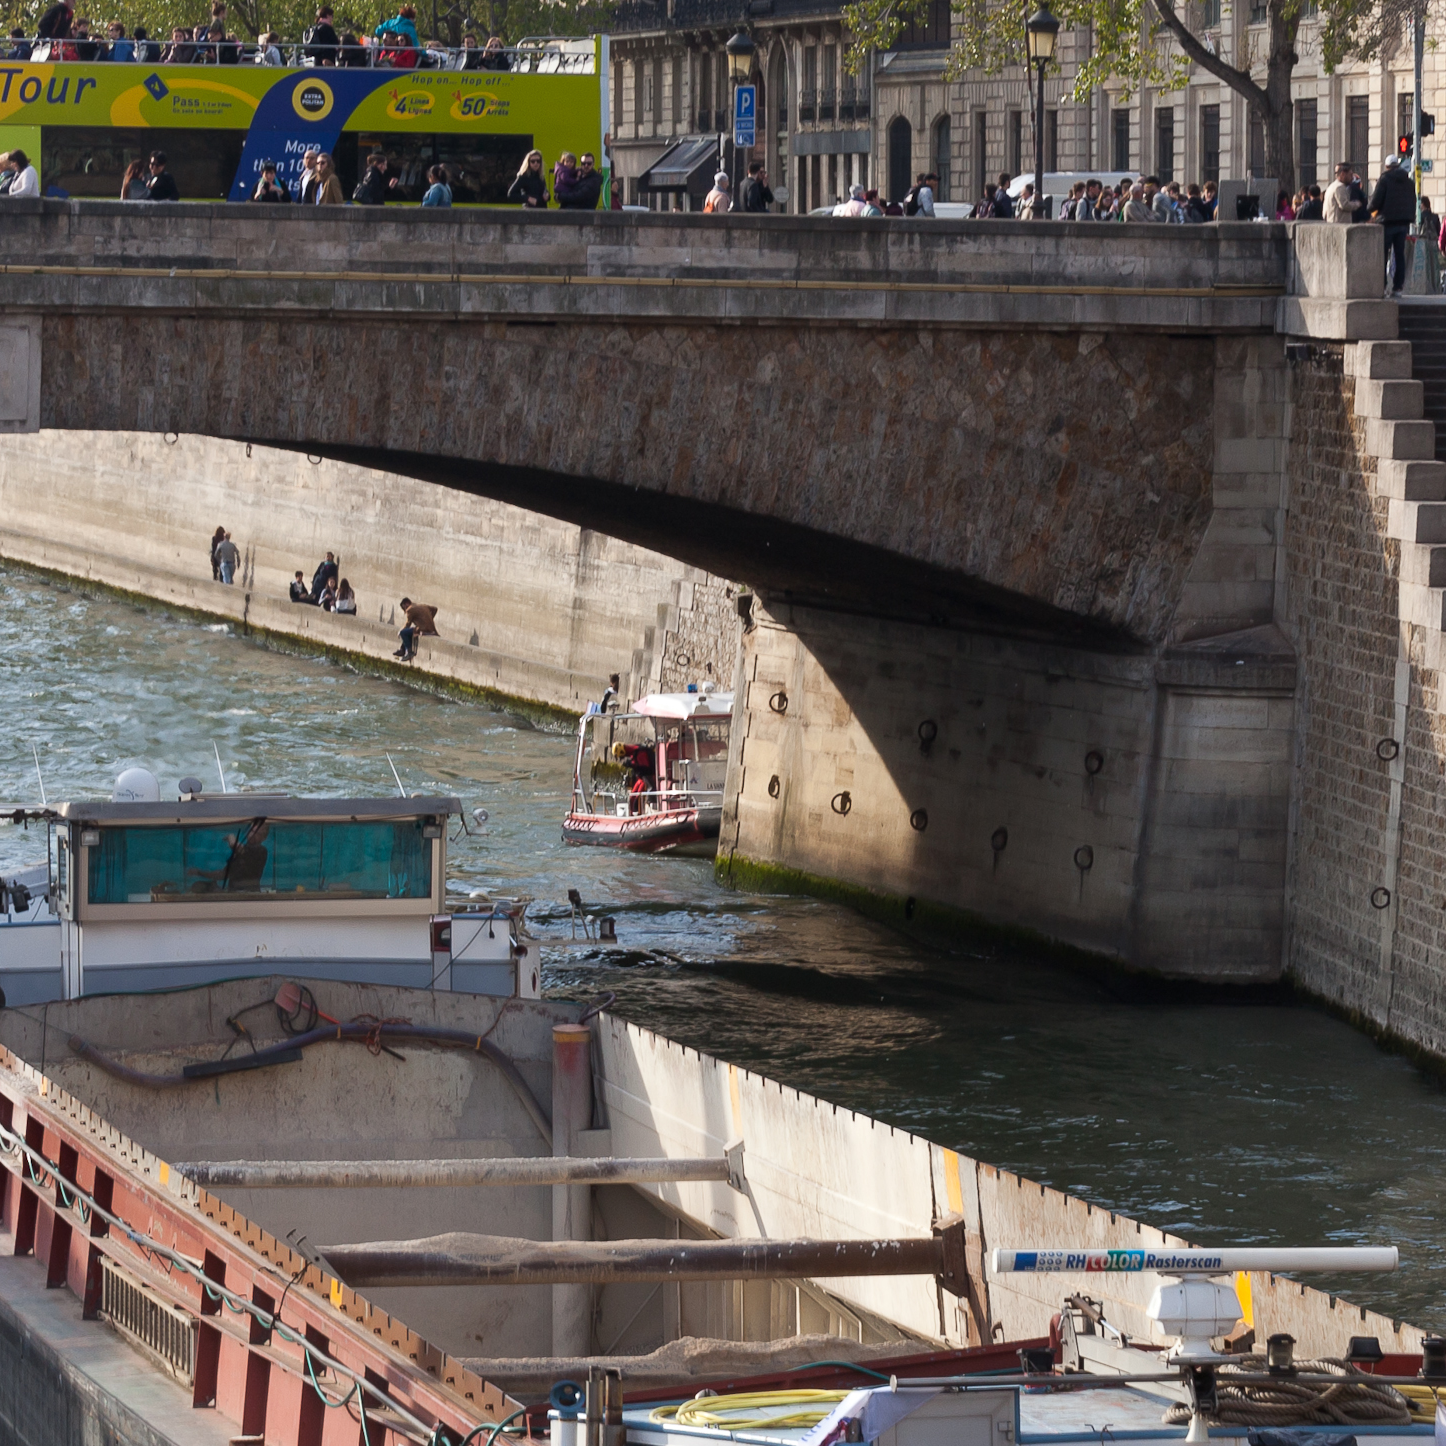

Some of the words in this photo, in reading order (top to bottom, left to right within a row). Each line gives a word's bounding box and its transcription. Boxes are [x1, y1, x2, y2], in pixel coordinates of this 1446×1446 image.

[461, 76, 482, 86] Hop
[173, 95, 200, 107] Pass
[395, 96, 407, 114] 4
[461, 98, 486, 116] 50
[741, 92, 751, 113] P
[285, 140, 321, 153] More
[253, 158, 285, 172] thn
[1145, 1254, 1221, 1269] Rasterscan
